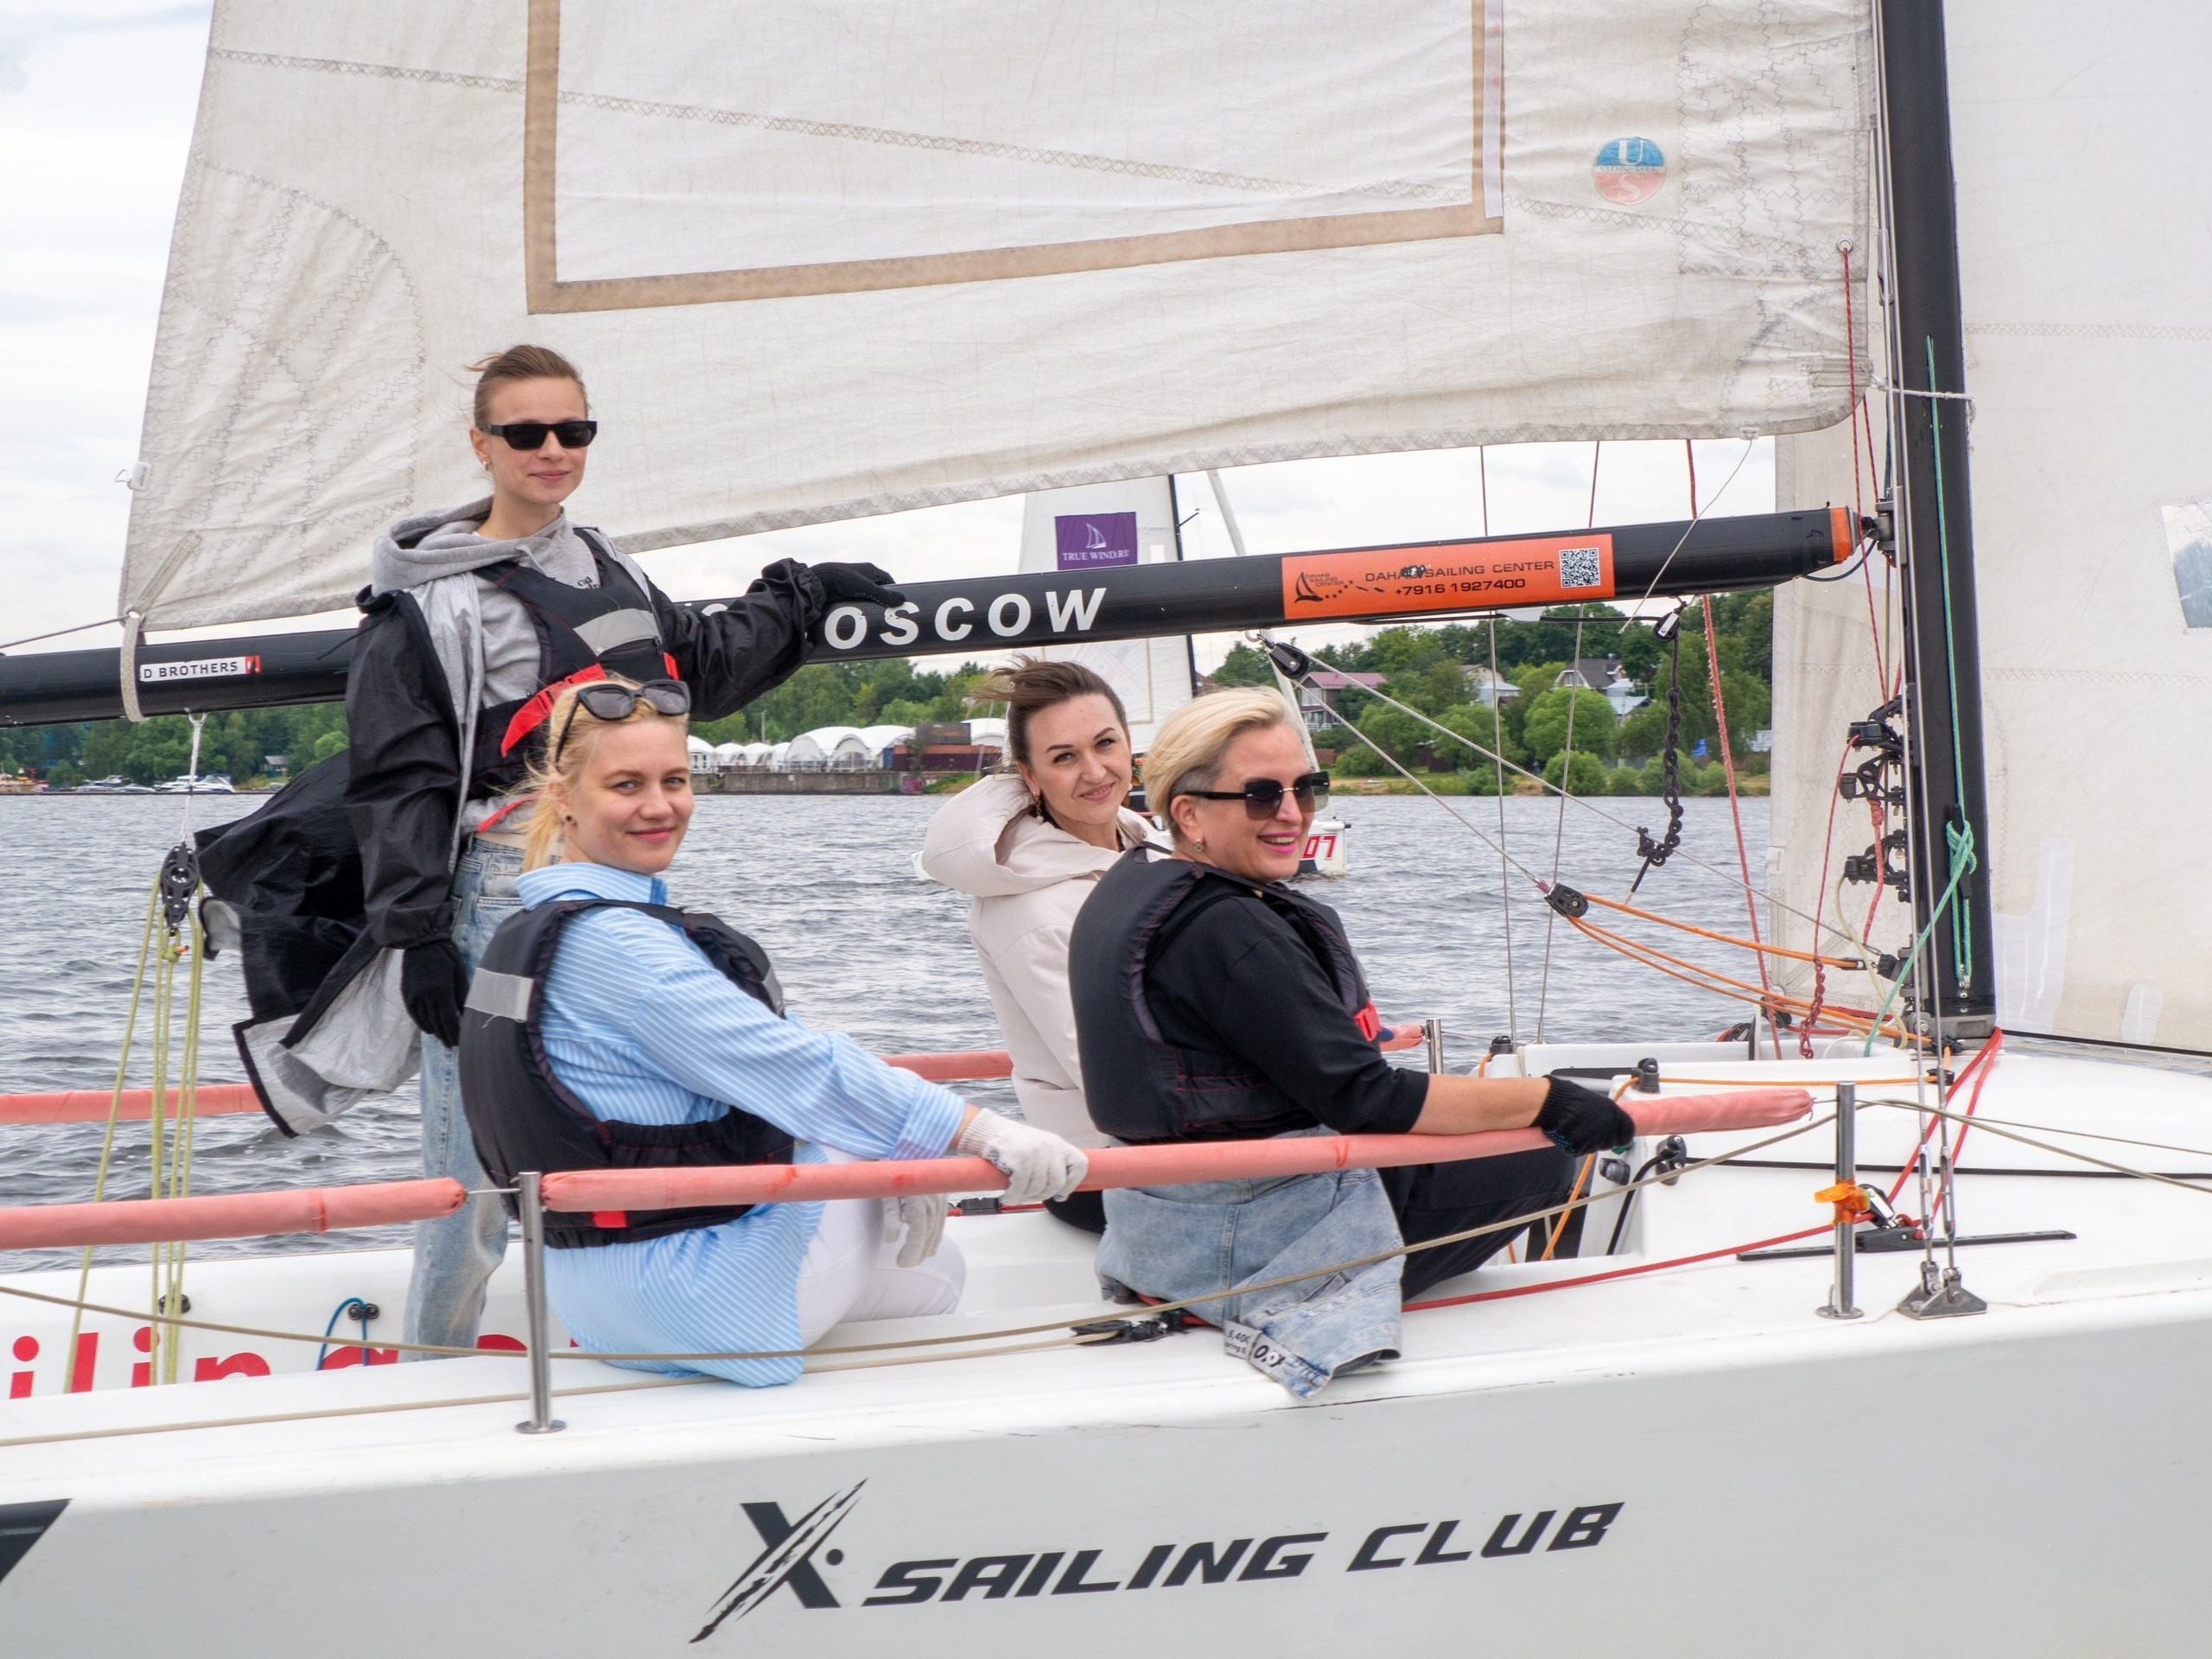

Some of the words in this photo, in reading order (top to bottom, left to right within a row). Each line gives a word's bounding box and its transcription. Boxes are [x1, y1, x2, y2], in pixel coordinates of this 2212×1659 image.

[1617, 140, 1645, 166] U
[1618, 174, 1641, 202] S
[1062, 551, 1088, 561] TRUE
[1365, 568, 1419, 582] DAH
[1424, 565, 1485, 578] SAILING
[1492, 561, 1554, 574] CENTER
[1395, 583, 1446, 596] +7916
[1451, 578, 1526, 593] 1927400
[804, 588, 1106, 650] OSCOW
[143, 668, 152, 679] D
[159, 661, 238, 677] BROTHERS
[861, 1531, 1331, 1607] SAILING
[1345, 1502, 1626, 1573] CLUB
